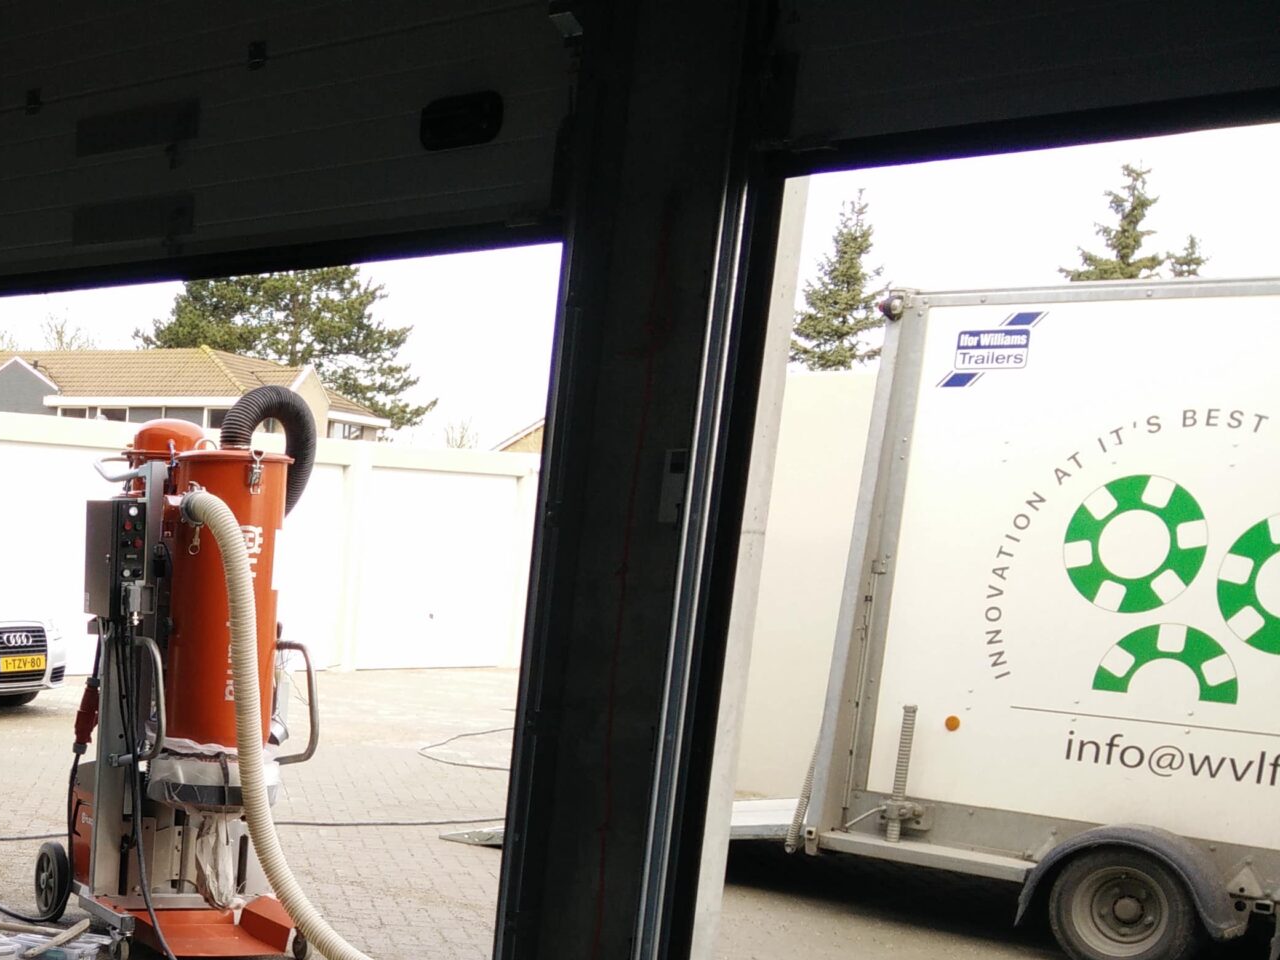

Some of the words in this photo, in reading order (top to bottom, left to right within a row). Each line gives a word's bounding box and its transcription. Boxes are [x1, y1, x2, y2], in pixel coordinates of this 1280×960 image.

[959, 333, 979, 347] Ifor
[980, 333, 1028, 346] Williams
[959, 351, 1024, 365] Trailers
[984, 490, 1047, 680] INNOVATION
[1053, 451, 1083, 486] AT
[1096, 414, 1162, 454] IT'S
[1181, 408, 1269, 434] BEST
[4, 657, 42, 670] 1-TZV-80
